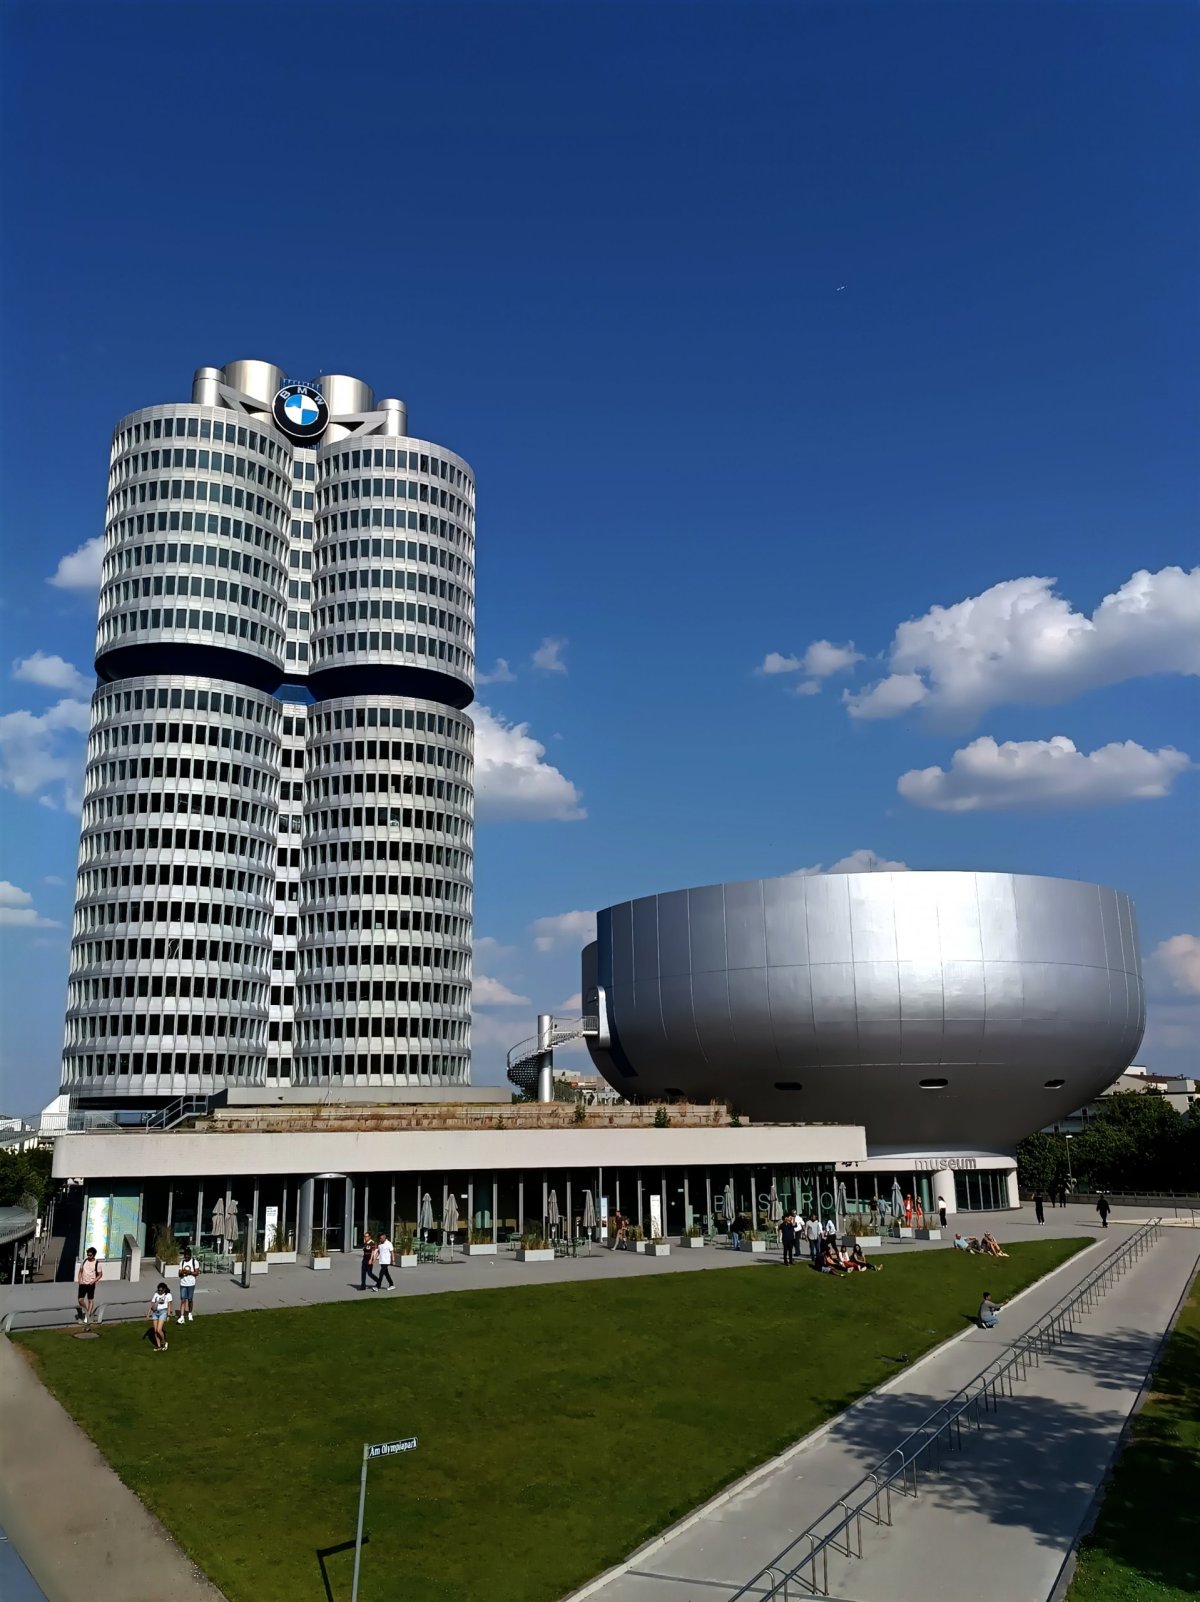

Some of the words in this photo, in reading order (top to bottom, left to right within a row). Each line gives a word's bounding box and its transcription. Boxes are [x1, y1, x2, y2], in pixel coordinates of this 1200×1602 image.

[280, 387, 324, 405] BMW
[914, 1158, 977, 1170] museum
[370, 1446, 381, 1457] Am
